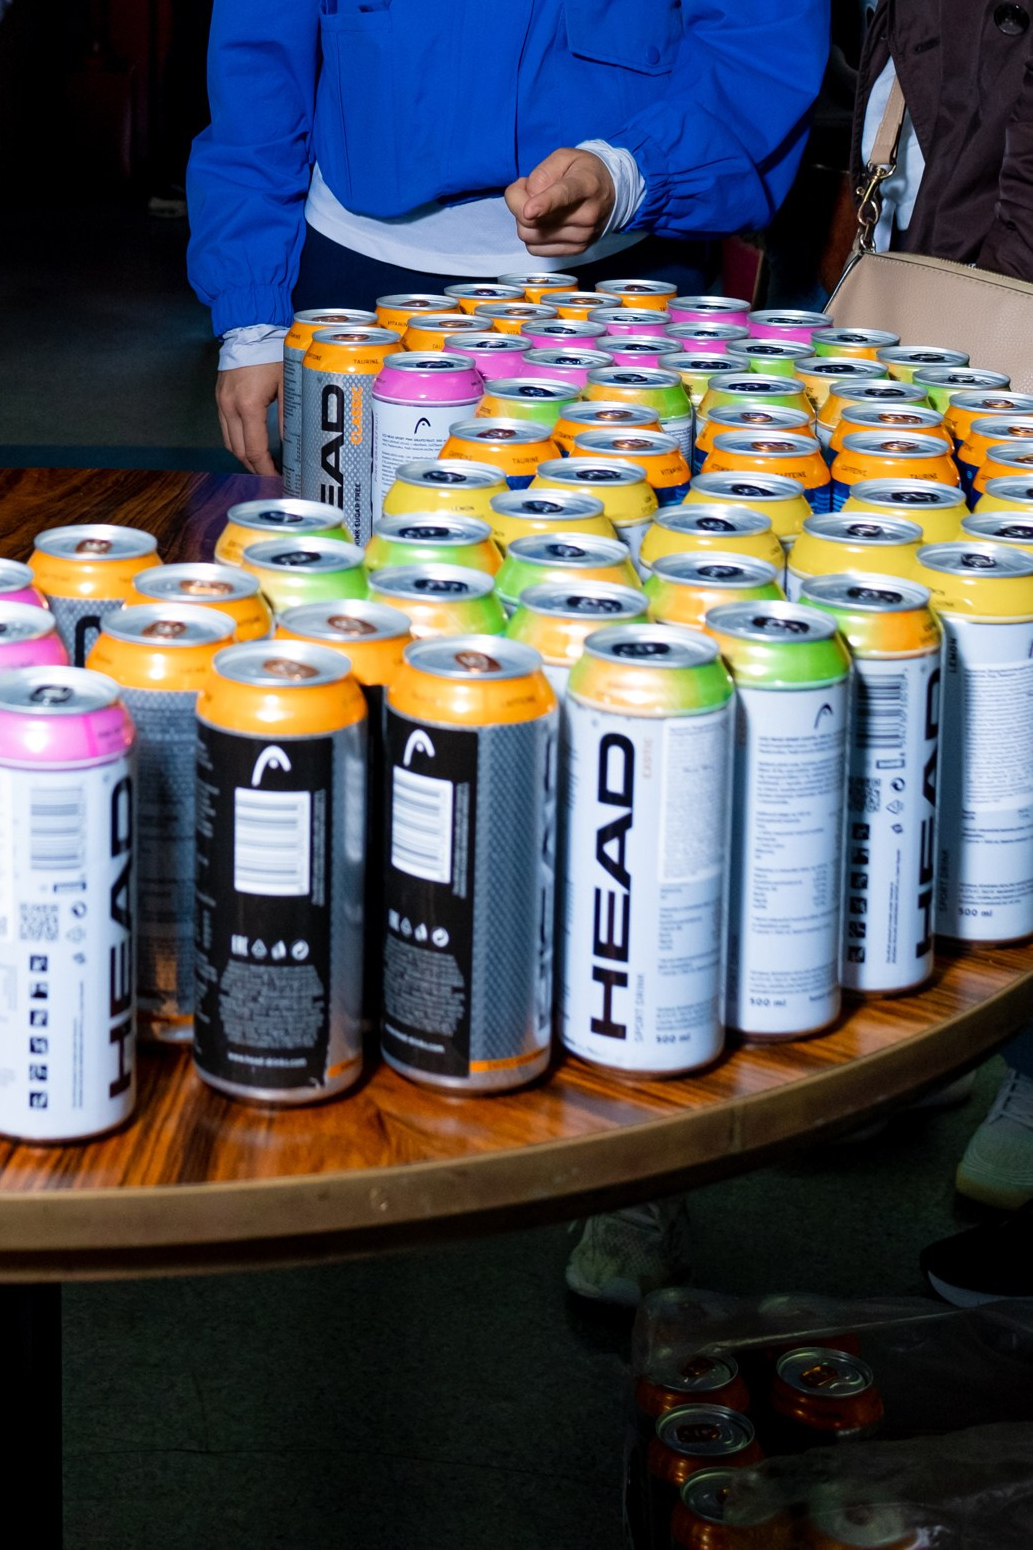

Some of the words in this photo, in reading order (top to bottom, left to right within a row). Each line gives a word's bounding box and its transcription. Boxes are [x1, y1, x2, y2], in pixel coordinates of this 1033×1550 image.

[350, 386, 364, 445] CLASSIC
[320, 384, 344, 510] EAD
[512, 456, 539, 464] TAURINE
[354, 483, 362, 501] FREE
[354, 503, 362, 528] SUGAR
[590, 732, 635, 1041] HEAD
[958, 907, 978, 917] 500
[981, 909, 993, 917] ml
[109, 776, 134, 1099] HEAD
